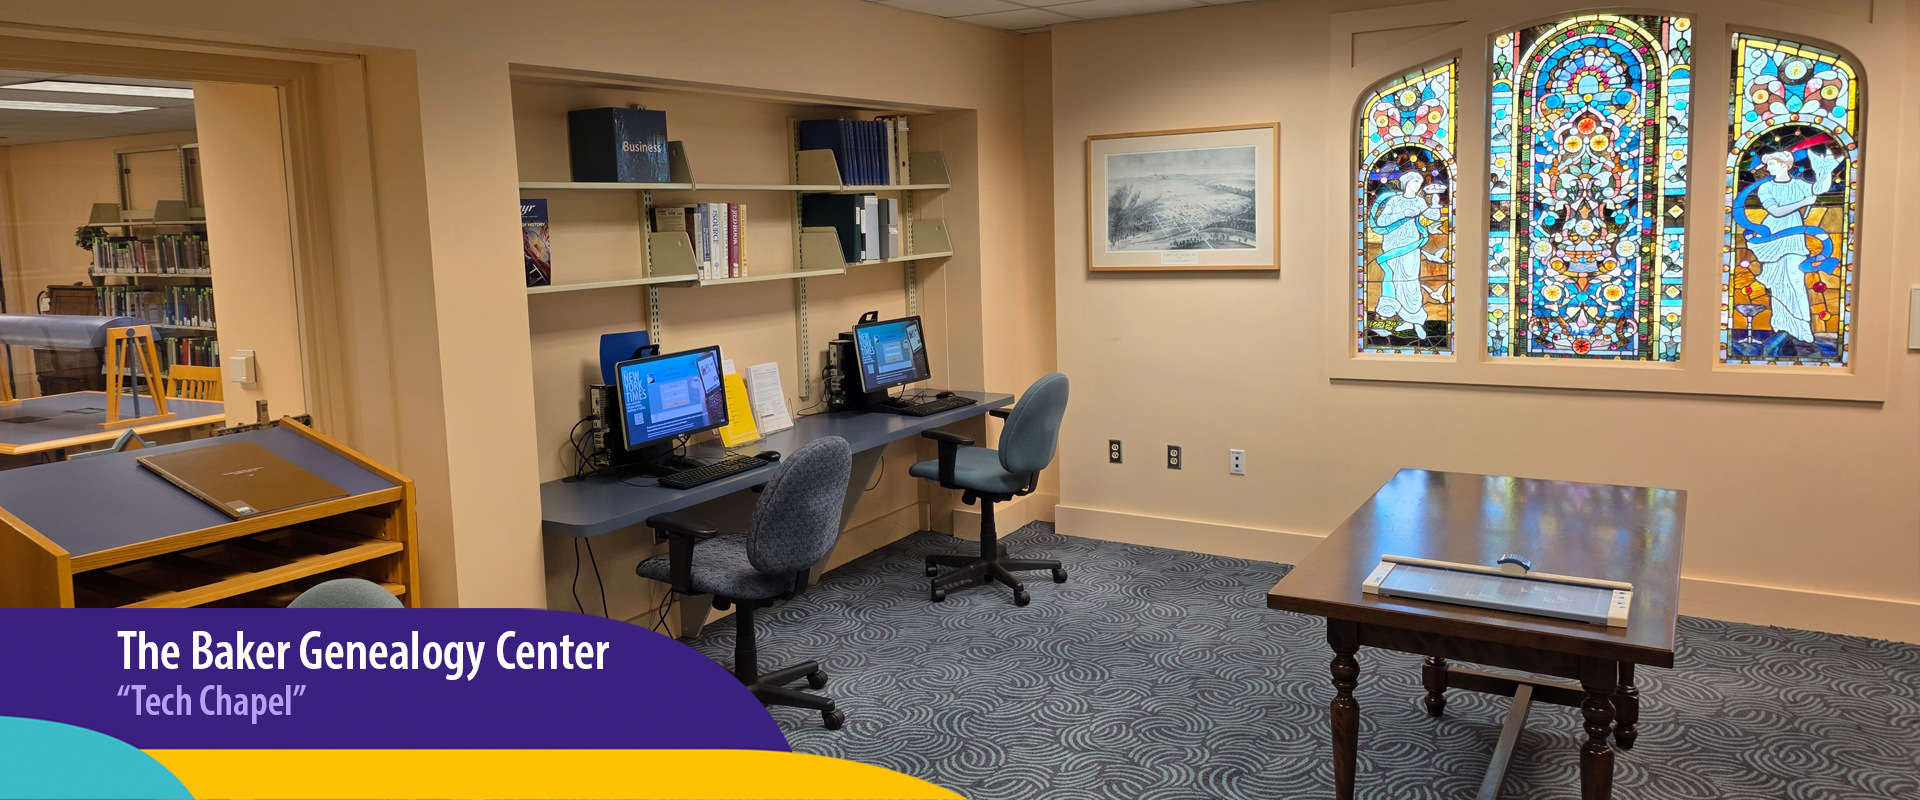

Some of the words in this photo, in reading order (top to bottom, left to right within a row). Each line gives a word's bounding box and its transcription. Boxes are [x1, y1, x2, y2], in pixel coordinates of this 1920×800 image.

[623, 140, 662, 153] Business
[711, 213, 719, 245] SOURCE
[623, 370, 640, 383] NEW
[624, 380, 644, 393] YORK
[625, 388, 647, 403] TIMES
